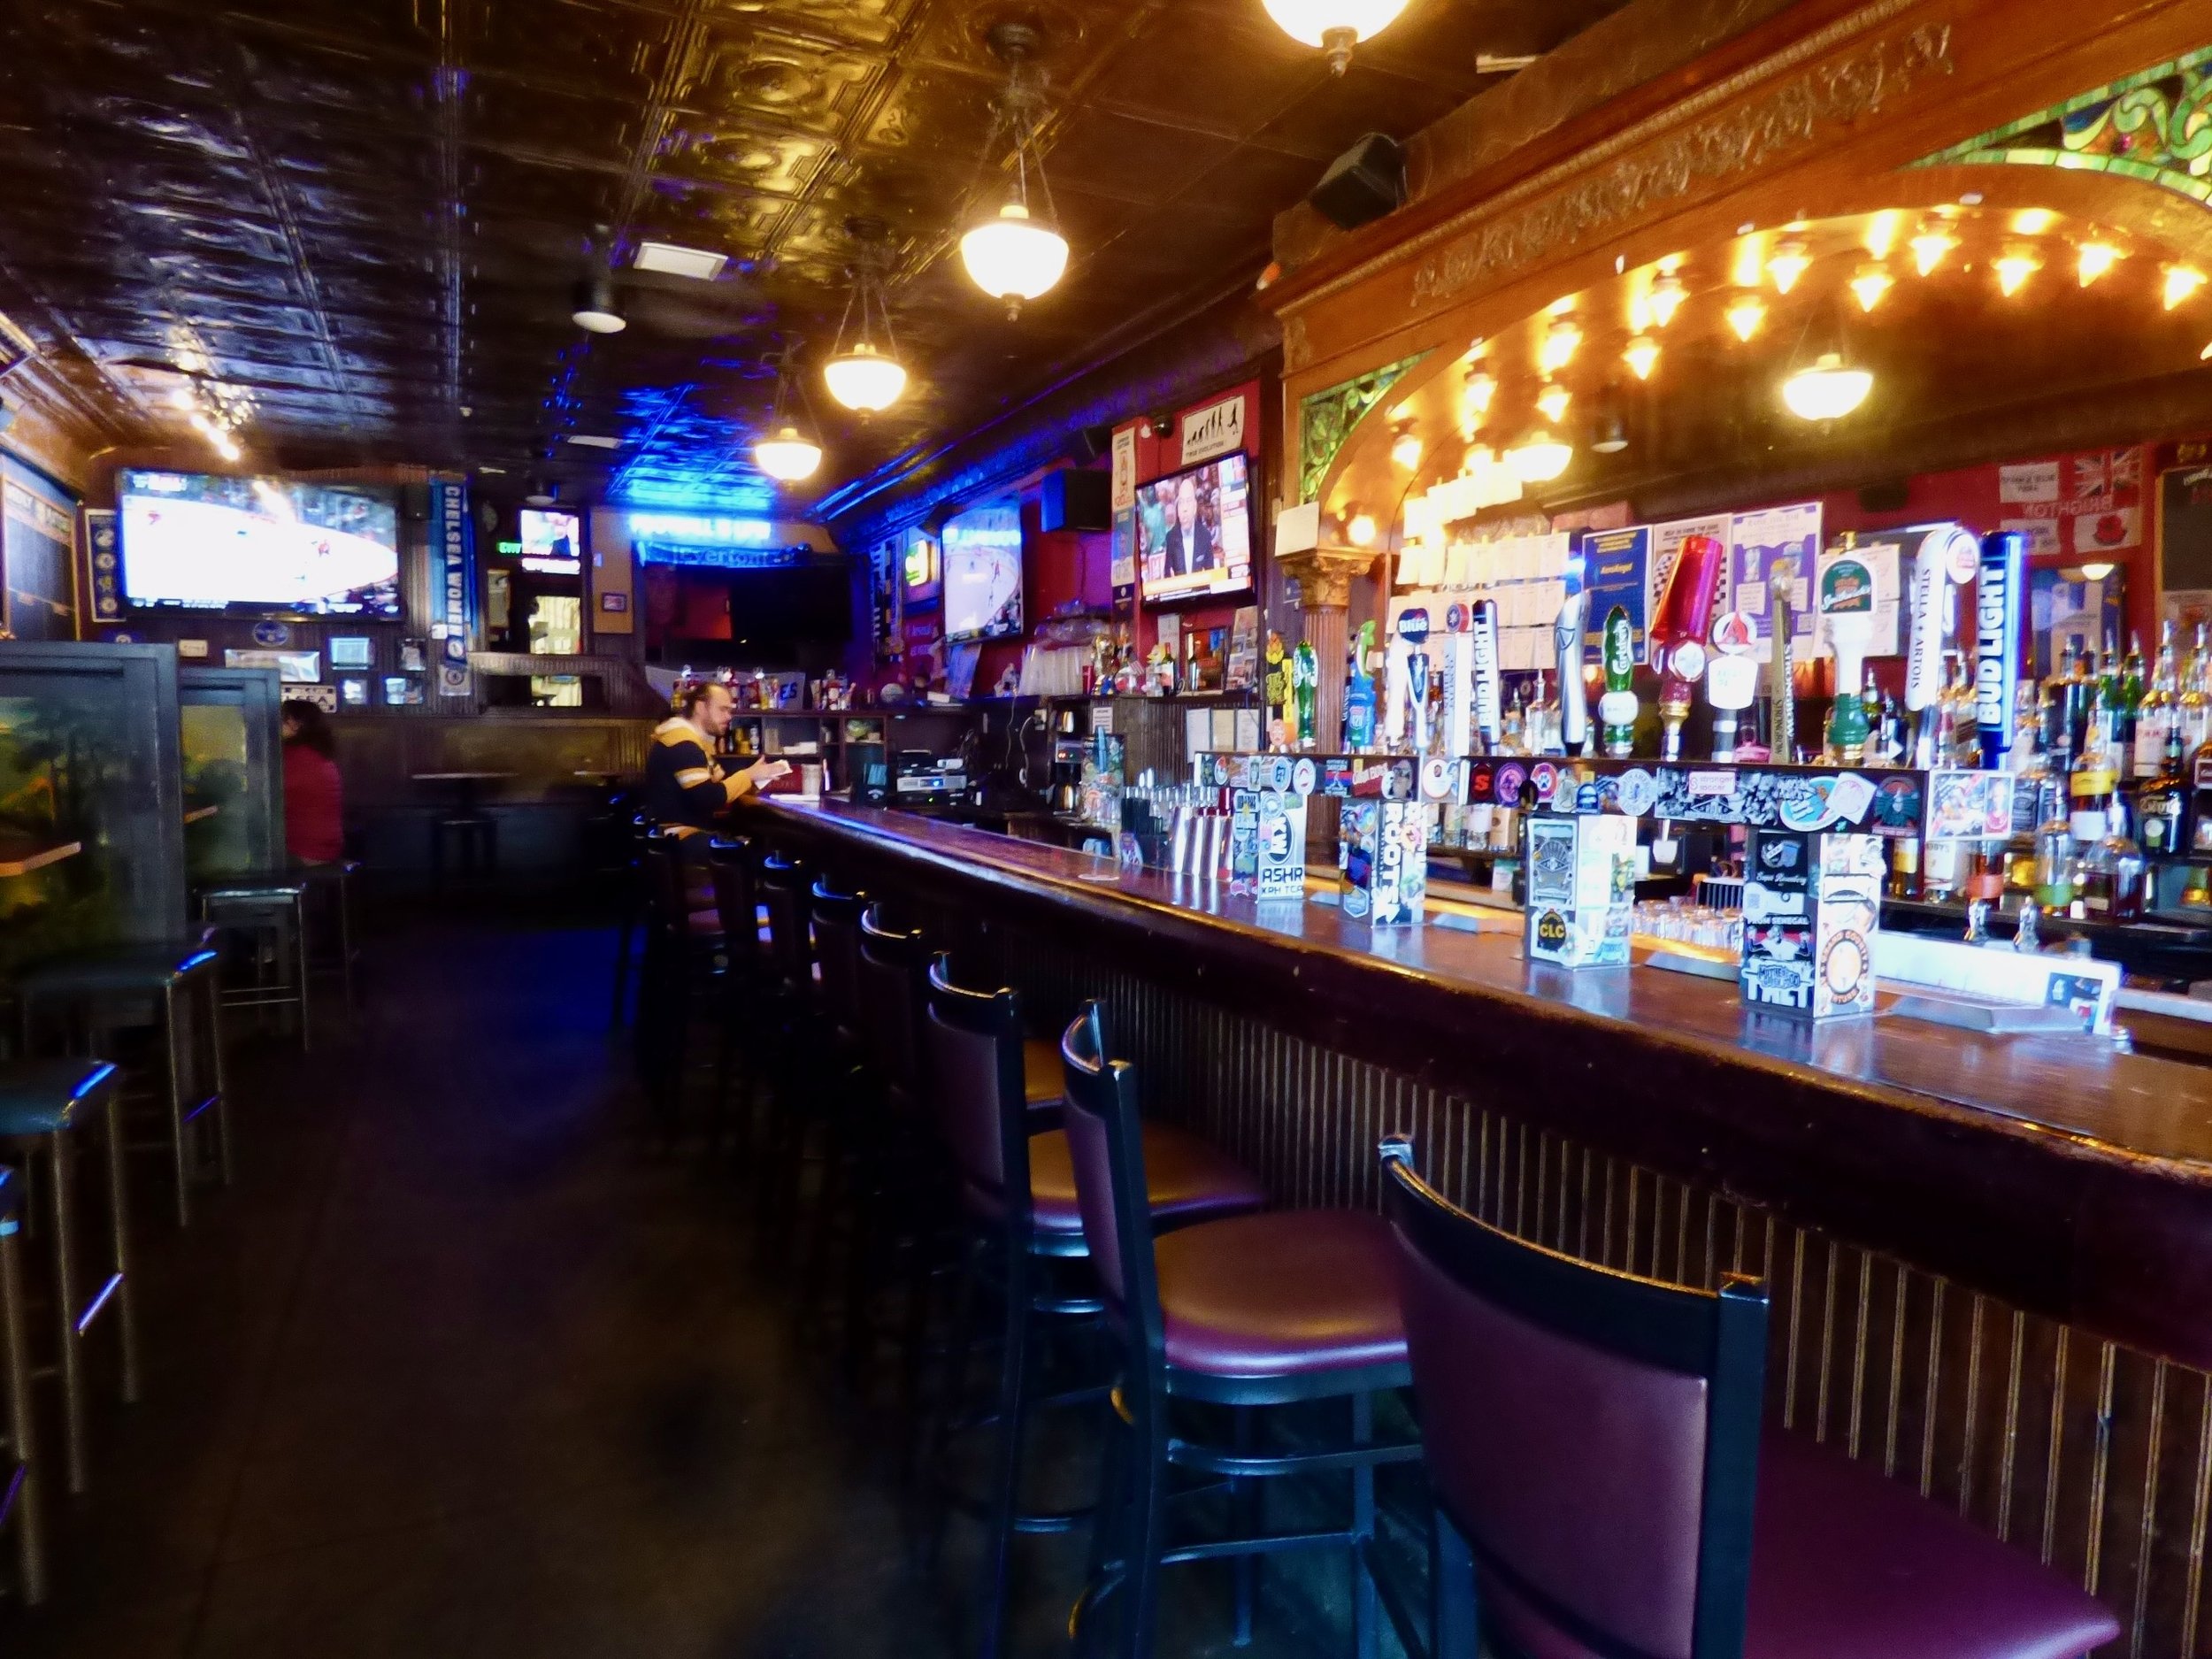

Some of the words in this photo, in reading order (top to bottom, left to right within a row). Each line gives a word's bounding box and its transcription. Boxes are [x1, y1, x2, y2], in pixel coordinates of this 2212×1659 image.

[444, 486, 462, 566] CHELSEA
[1916, 567, 1932, 620] STELLA
[1978, 565, 2005, 657] LIGHT
[1398, 619, 1428, 634] Blue
[1473, 619, 1491, 684] LIGHT
[1909, 639, 1925, 689] ARTOIS
[1978, 658, 2003, 726] BUD
[1476, 681, 1492, 727] BUD
